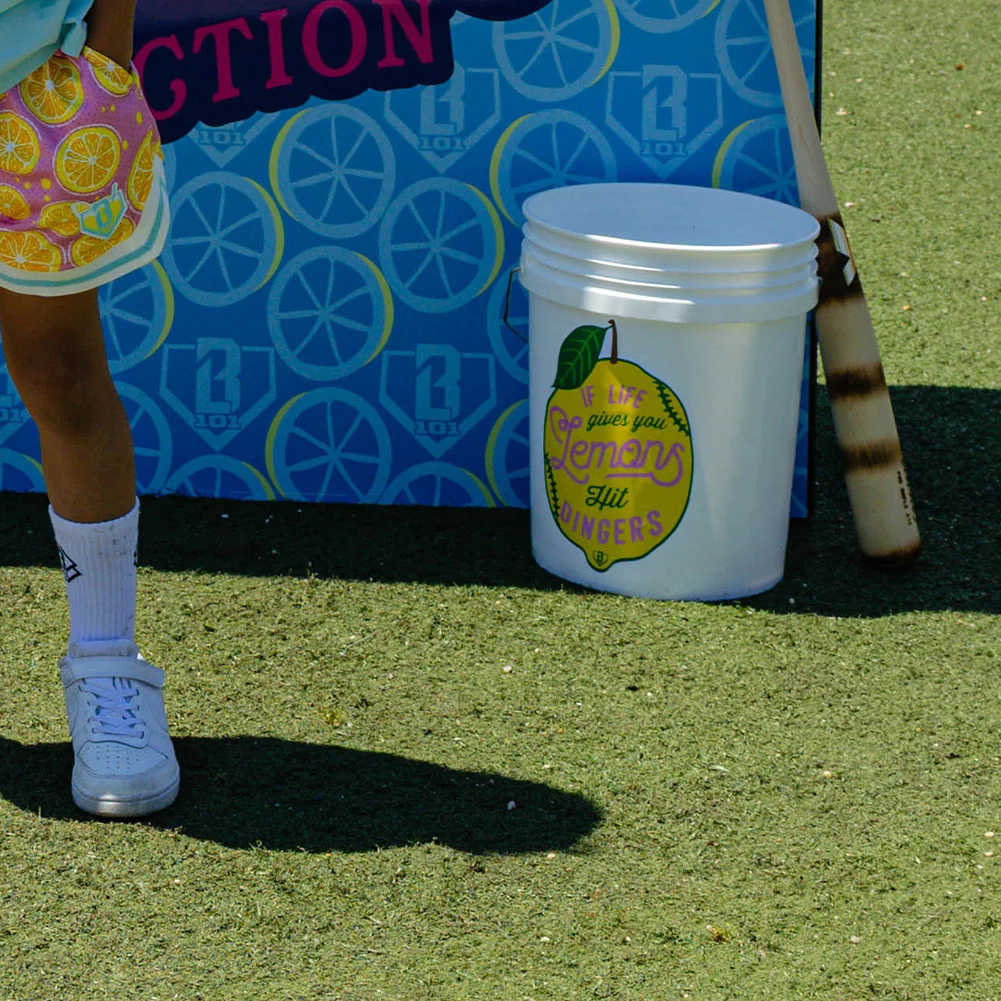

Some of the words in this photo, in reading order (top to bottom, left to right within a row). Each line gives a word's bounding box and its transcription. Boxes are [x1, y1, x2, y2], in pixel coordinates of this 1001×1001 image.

[580, 385, 595, 408] IF
[608, 384, 648, 409] LIFE
[586, 411, 627, 432] gives
[631, 415, 669, 432] you
[550, 406, 685, 487] Lemons
[585, 484, 629, 510] Hit
[561, 501, 663, 545] DINGERS
